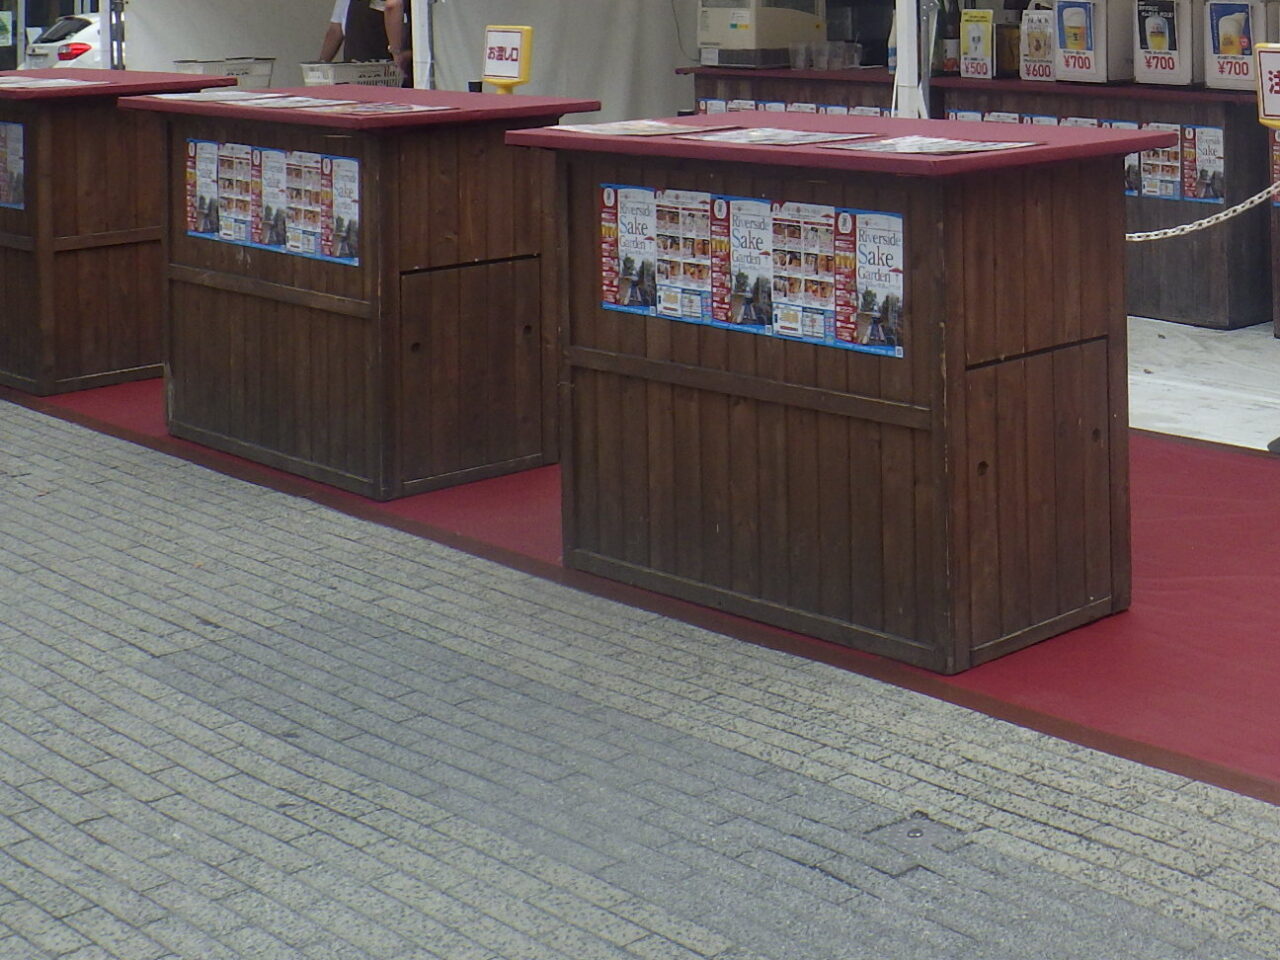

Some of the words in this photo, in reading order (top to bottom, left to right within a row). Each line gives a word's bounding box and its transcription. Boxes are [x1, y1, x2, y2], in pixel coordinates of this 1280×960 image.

[965, 62, 988, 75] ¥500
[1064, 55, 1091, 69] ¥700
[1145, 55, 1175, 70] ¥700
[1217, 61, 1249, 76] ¥700
[1025, 64, 1051, 77] ¥600
[620, 215, 648, 236] Sake
[732, 228, 763, 251] Sake
[858, 244, 893, 268] Sake
